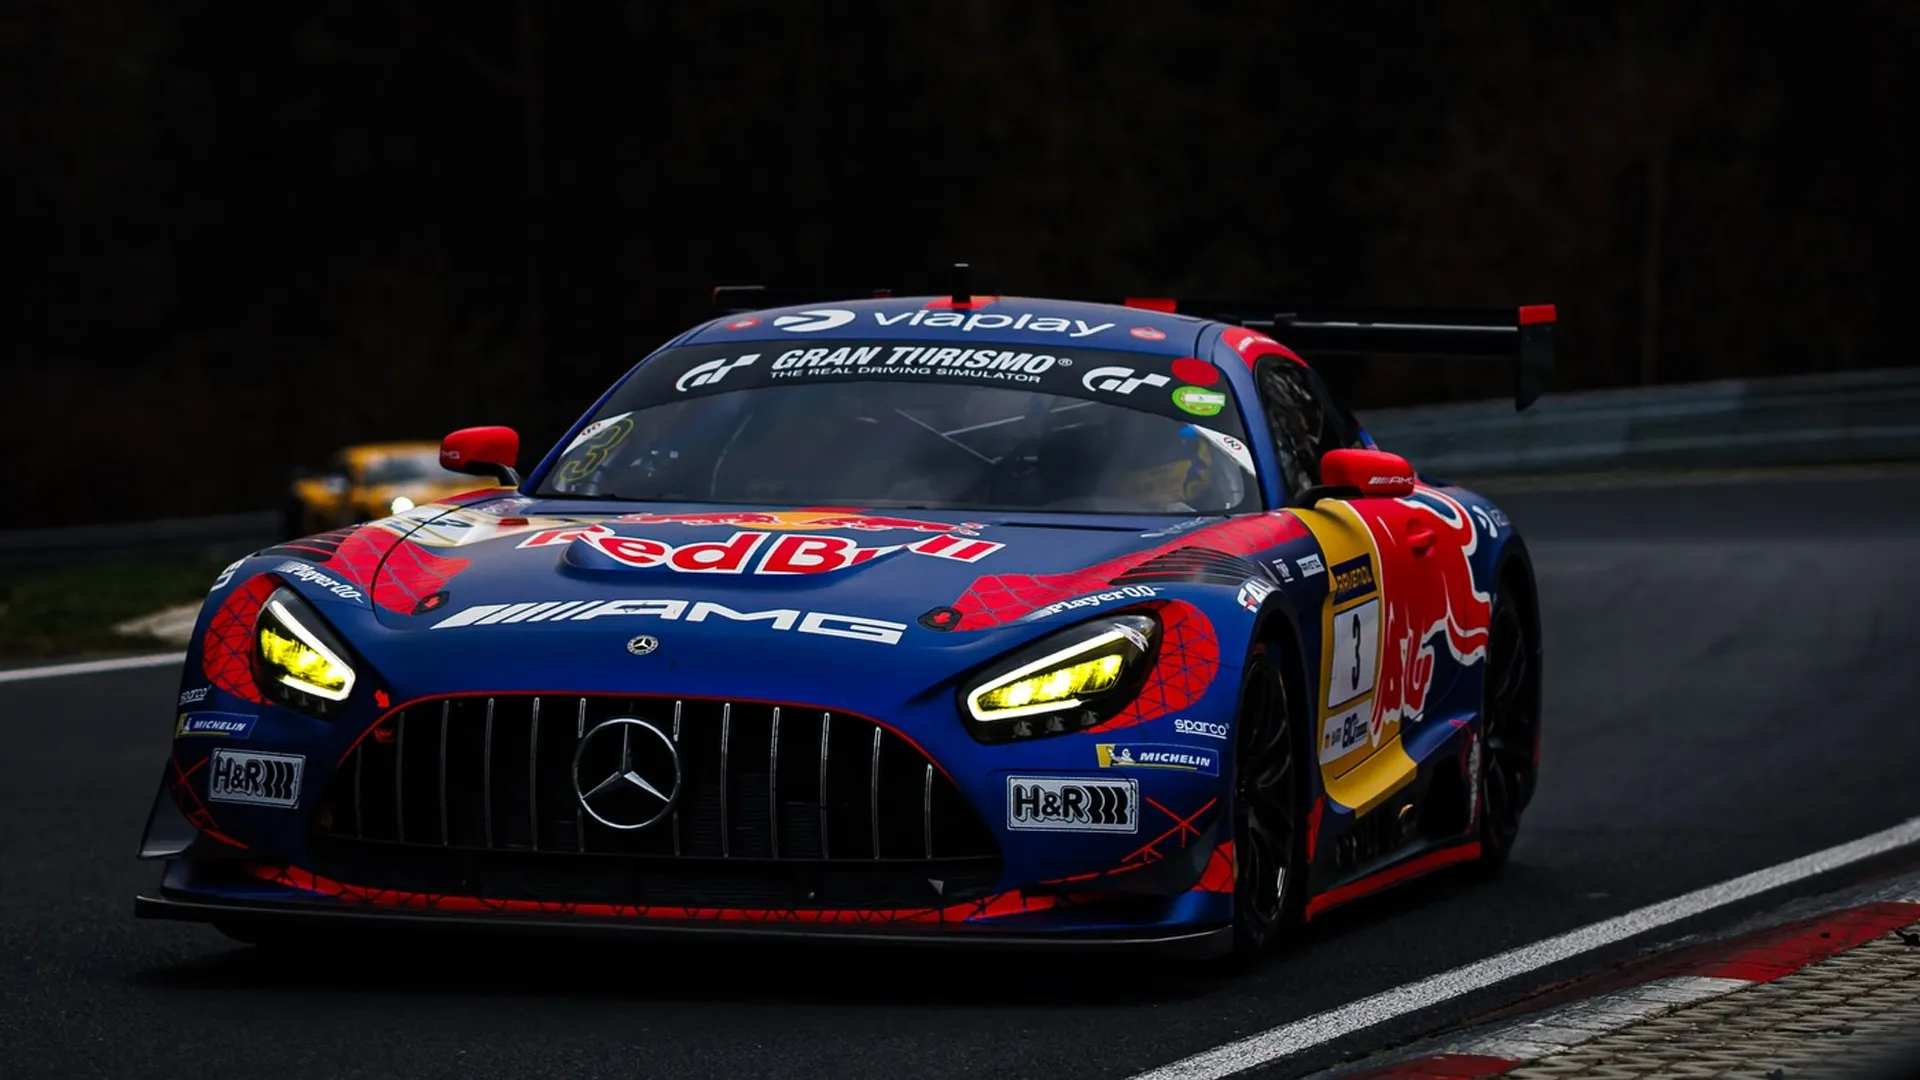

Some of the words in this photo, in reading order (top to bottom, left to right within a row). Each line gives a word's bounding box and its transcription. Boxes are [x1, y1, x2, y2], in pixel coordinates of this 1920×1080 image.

[873, 309, 1116, 338] viaplay
[769, 369, 802, 379] THE
[807, 366, 856, 376] REAL
[857, 365, 931, 375] DRIVING
[935, 367, 1042, 384] SIMULATOR
[770, 346, 882, 371] GRAN
[560, 417, 634, 483] 3
[514, 523, 768, 574] Red
[571, 599, 908, 646] AMG
[1351, 613, 1361, 690] 3
[193, 720, 247, 732] MICHELIN
[1139, 751, 1211, 768] MICHELIN
[1013, 784, 1092, 824] H&R
